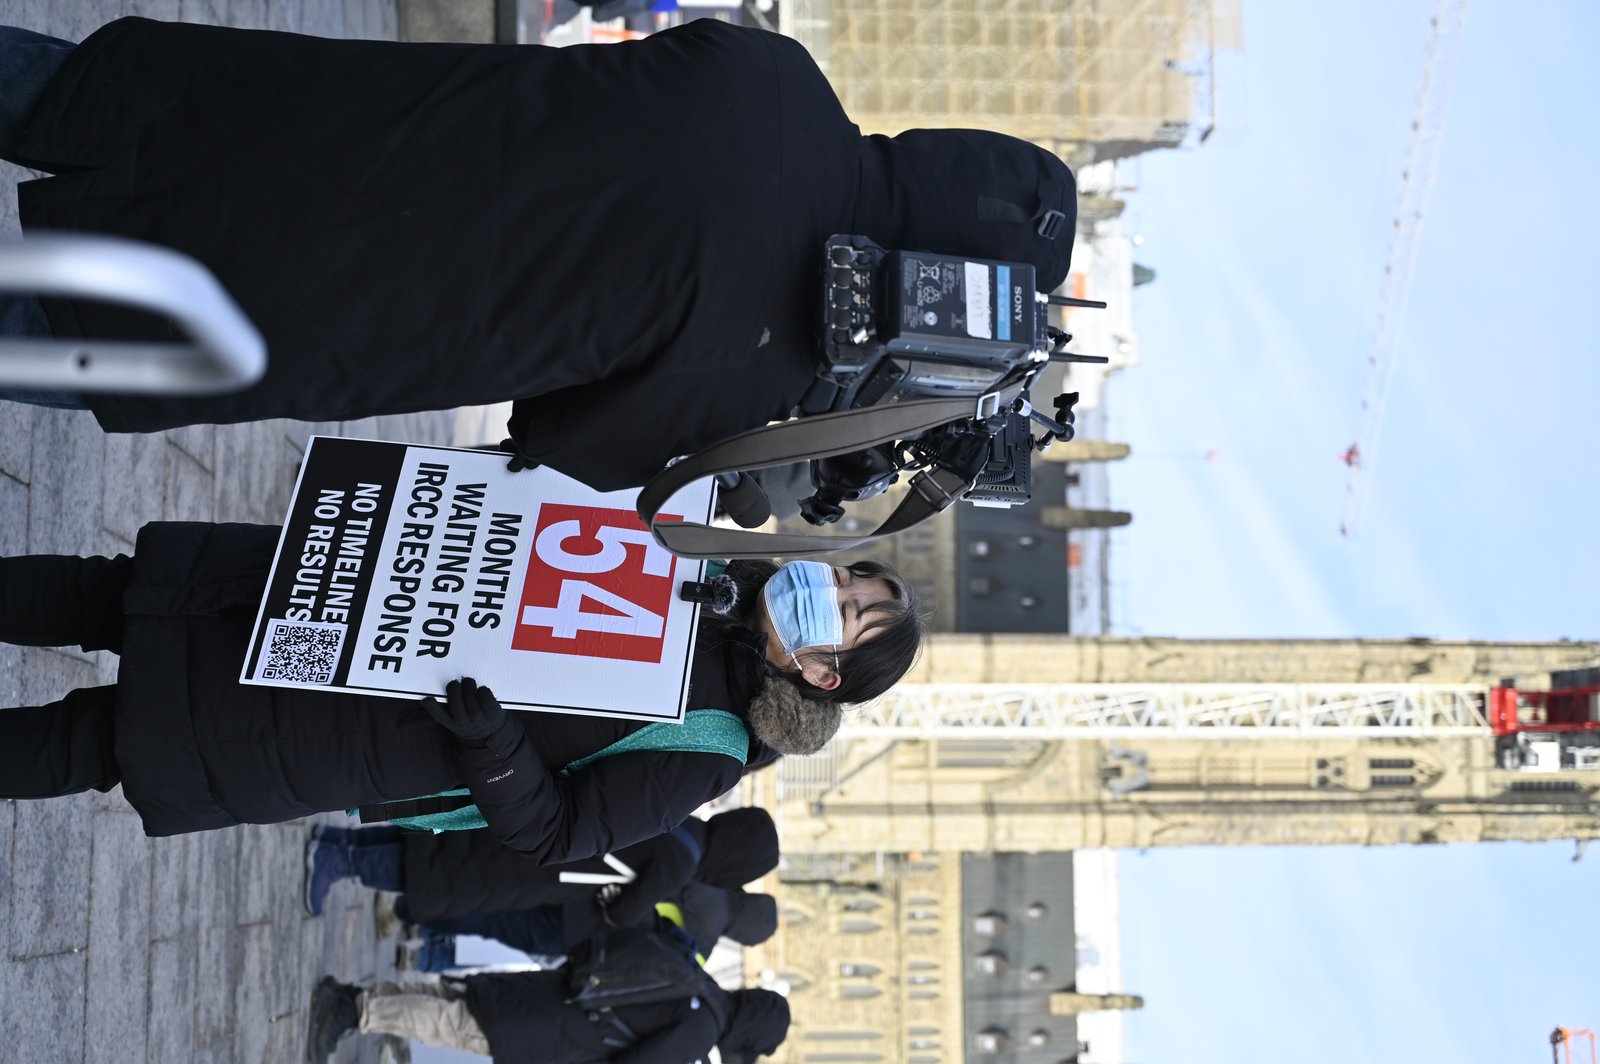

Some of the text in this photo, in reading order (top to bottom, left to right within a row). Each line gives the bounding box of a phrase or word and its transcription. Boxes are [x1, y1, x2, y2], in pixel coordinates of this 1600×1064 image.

[1014, 286, 1022, 323] SONY
[285, 490, 345, 622] NO RESULTS
[319, 483, 382, 624] NO TIMELINE
[368, 463, 449, 673] IRCC RESPONSE
[415, 483, 487, 658] WAITING FOR
[467, 513, 522, 629] MONTHS
[521, 520, 673, 639] 54
